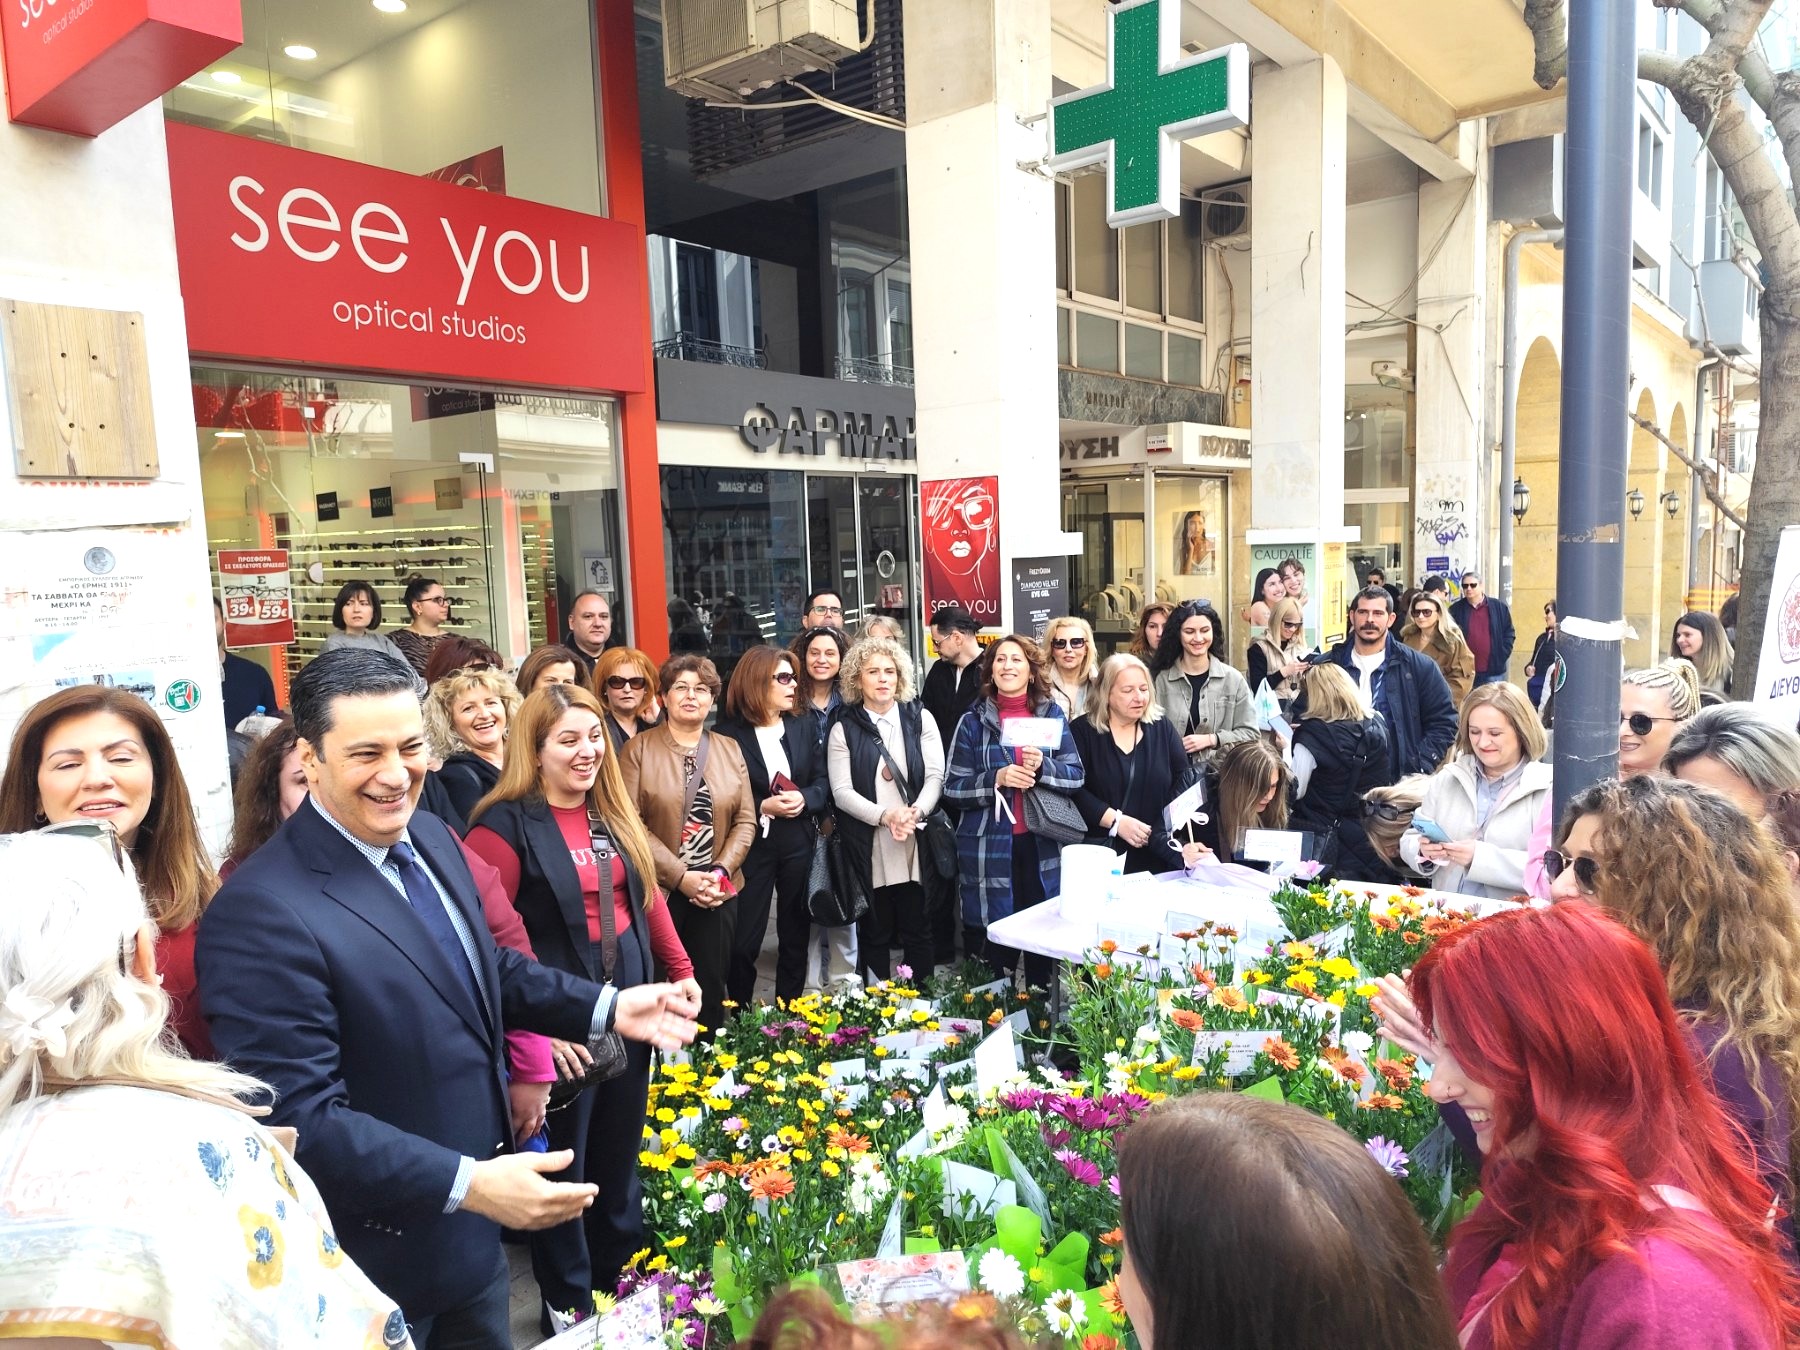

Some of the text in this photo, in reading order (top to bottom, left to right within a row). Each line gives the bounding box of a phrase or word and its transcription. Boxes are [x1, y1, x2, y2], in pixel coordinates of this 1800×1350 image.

[42, 12, 68, 44] optical
[228, 175, 590, 306] see you
[332, 300, 526, 344] optical studios
[1060, 435, 1119, 461] ΥΣΗ
[45, 592, 84, 600] ΣΑΒΒΑΤΑ
[964, 599, 997, 615] you
[260, 605, 287, 619] 59€
